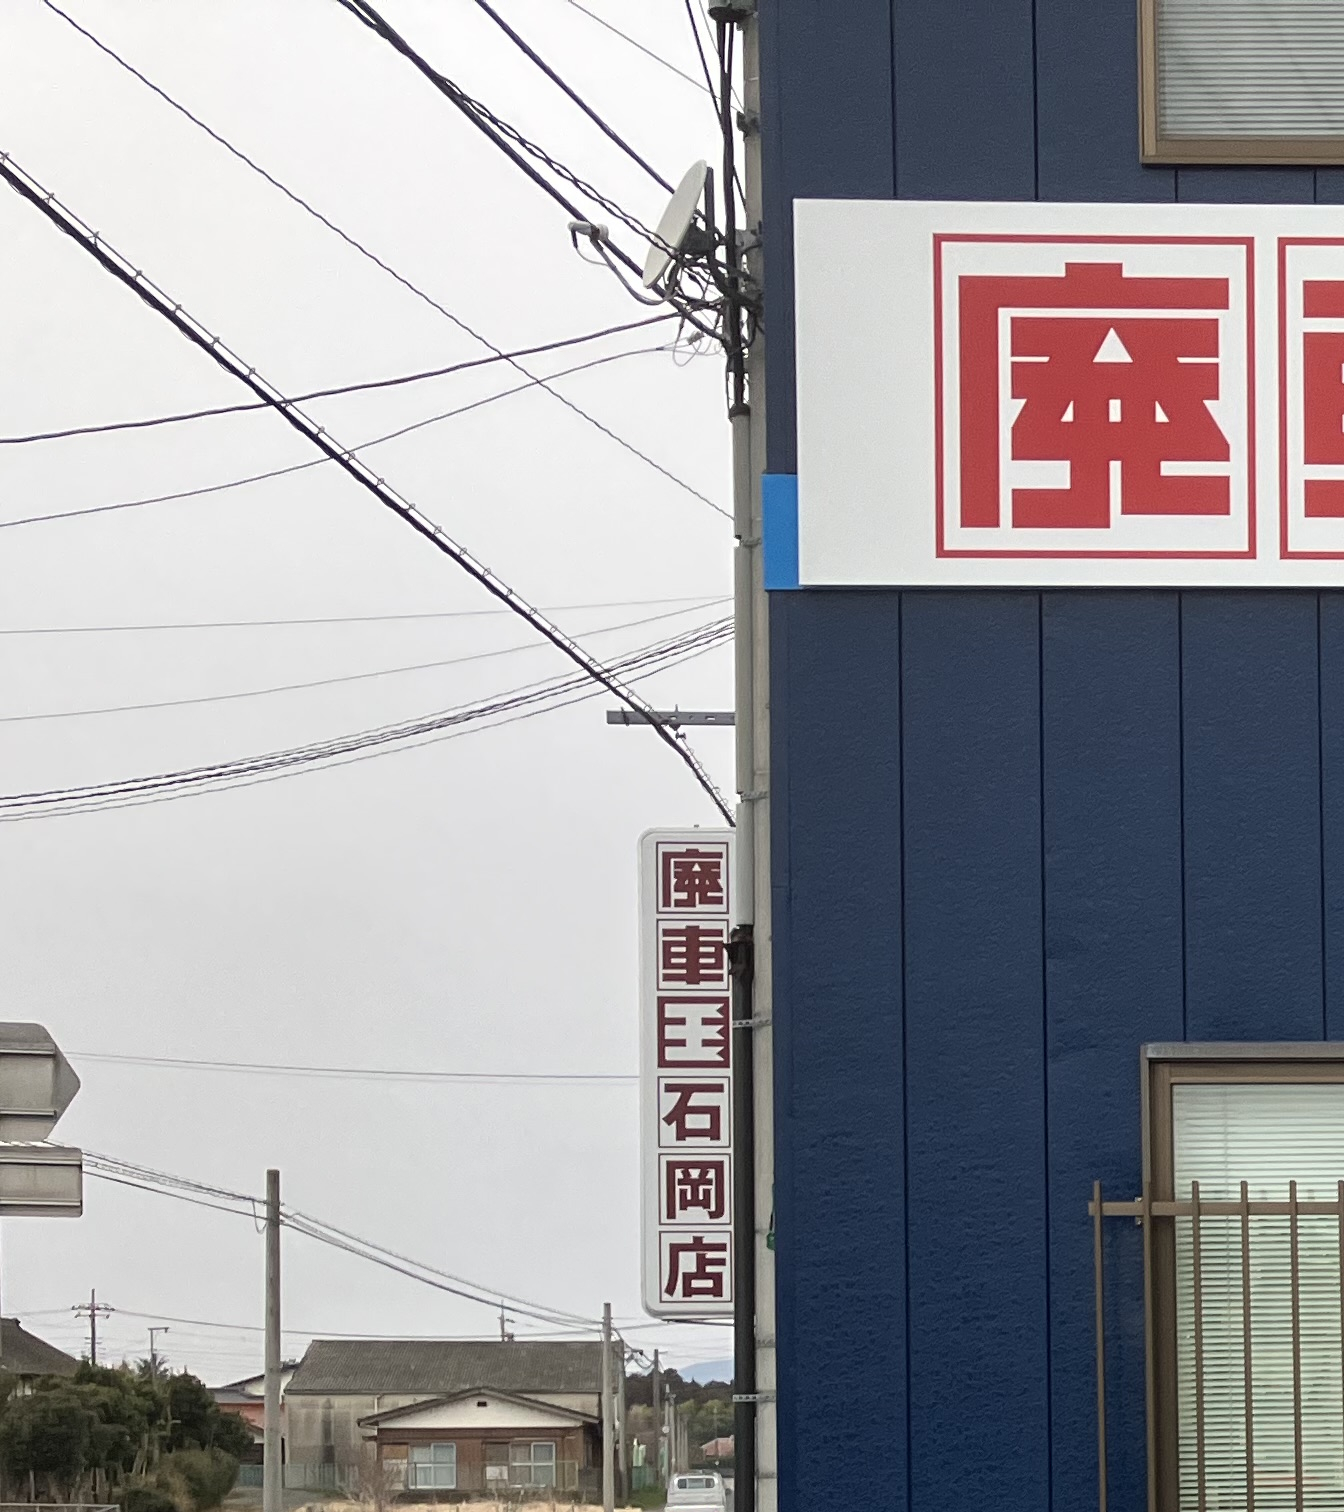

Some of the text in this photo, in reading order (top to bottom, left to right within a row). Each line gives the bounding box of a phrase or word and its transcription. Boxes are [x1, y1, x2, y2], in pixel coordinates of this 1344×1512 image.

[657, 848, 731, 1299] 廃車王石岡店
